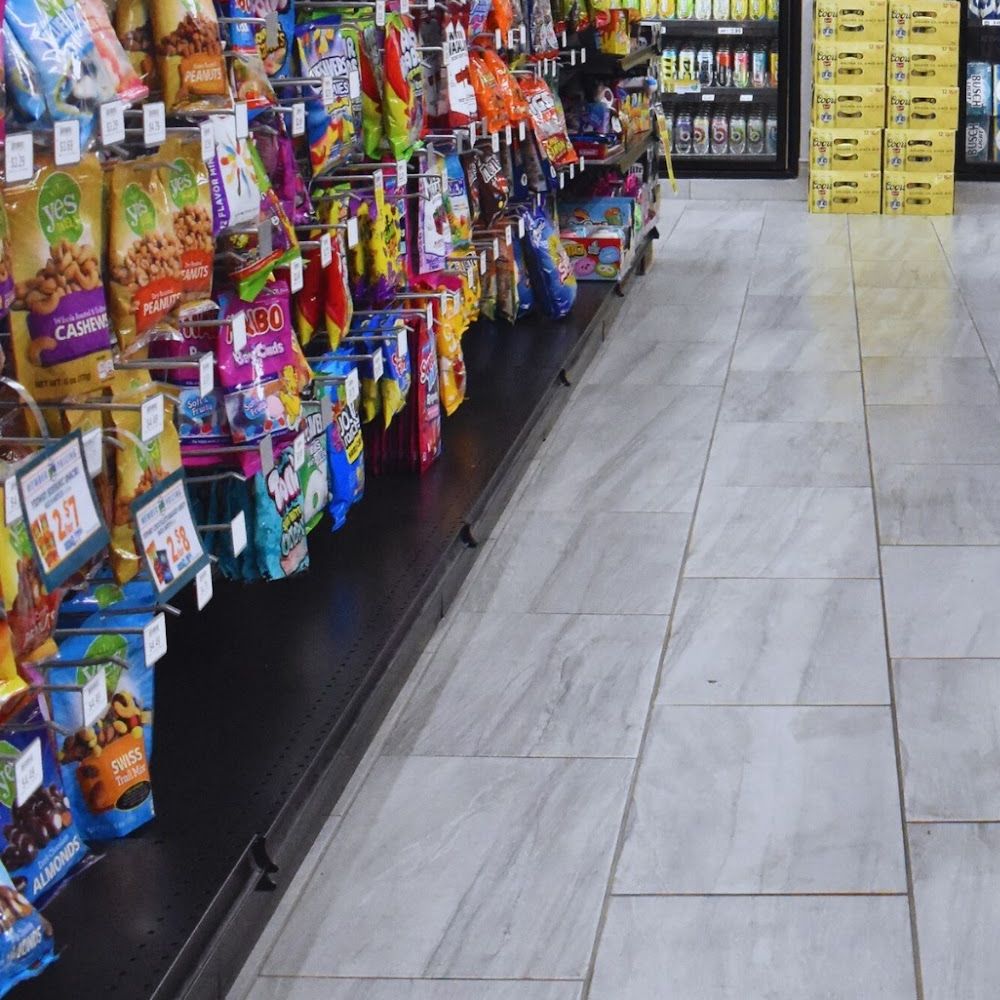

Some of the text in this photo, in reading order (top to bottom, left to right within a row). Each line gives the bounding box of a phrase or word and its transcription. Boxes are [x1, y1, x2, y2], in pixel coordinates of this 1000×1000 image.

[184, 66, 223, 83] PEANUTS
[971, 75, 982, 108] BUSCH
[968, 123, 979, 157] BUSCH
[169, 172, 194, 199] yes
[211, 179, 229, 216] FLAVOR
[41, 192, 79, 233] yes
[125, 197, 150, 227] yes
[219, 218, 228, 231] 12
[180, 264, 209, 282] EANUTS
[53, 314, 75, 326] Whole
[52, 508, 66, 543] 2
[165, 533, 179, 564] 2
[110, 746, 144, 776] SWISS
[115, 764, 148, 788] Trail Mix
[32, 836, 81, 896] ALMONDS
